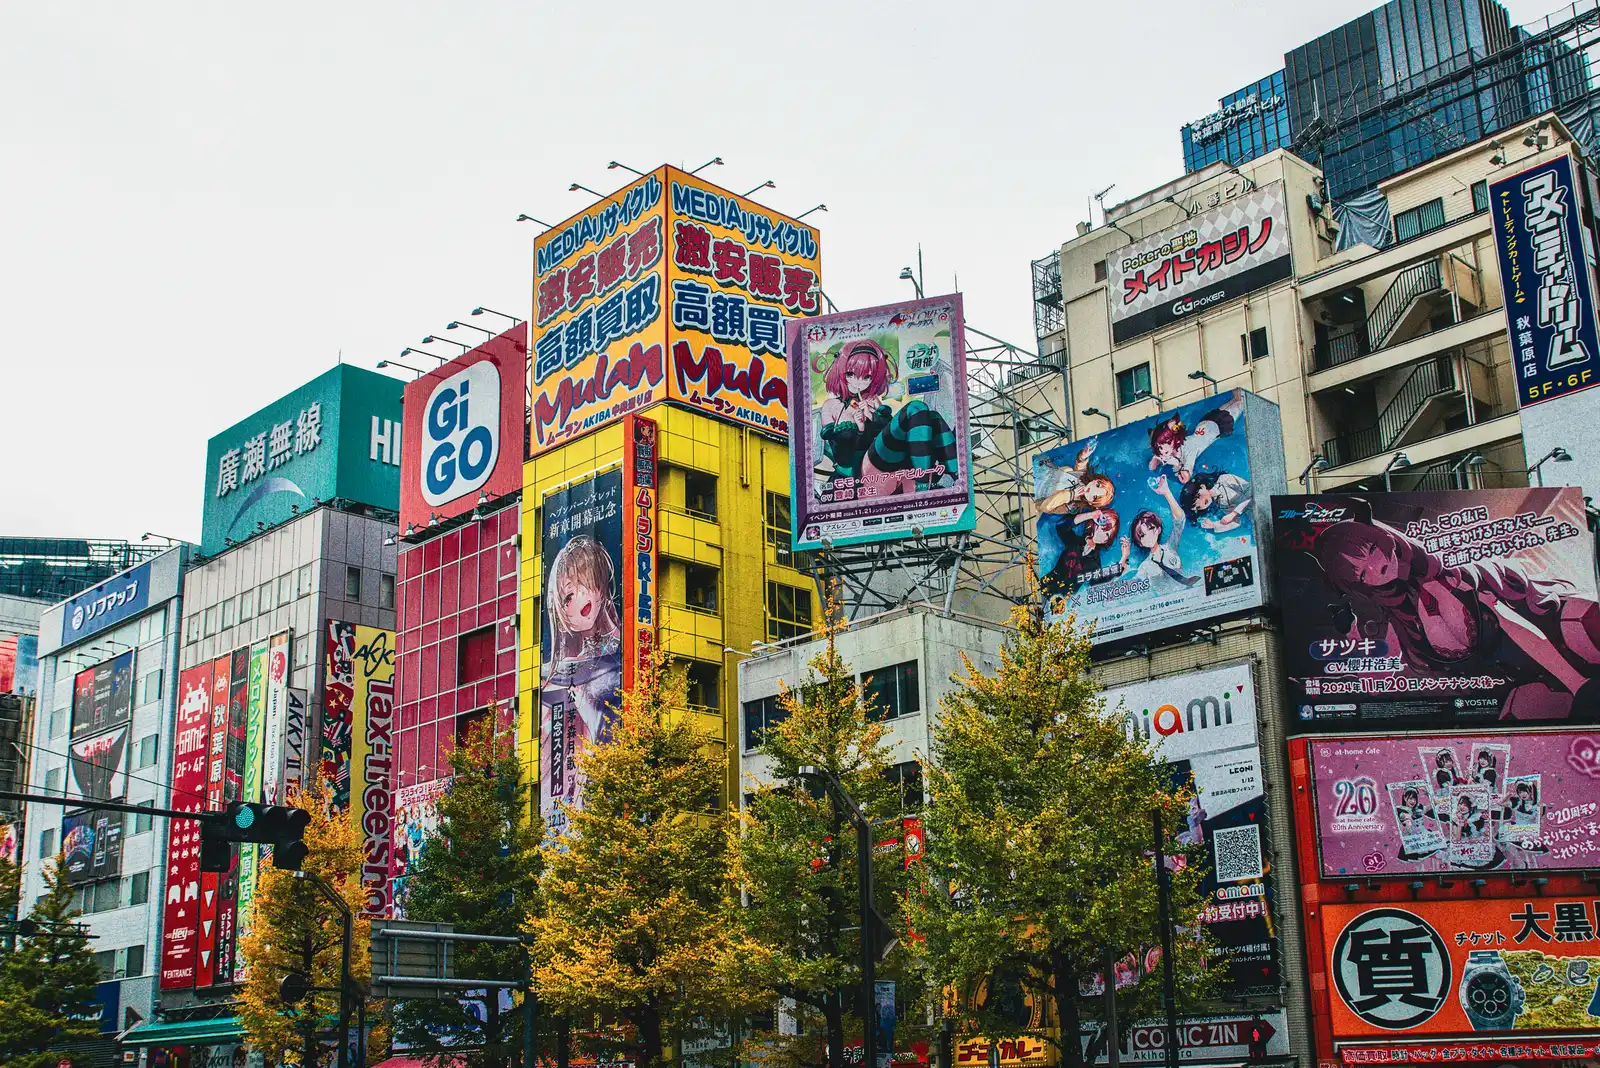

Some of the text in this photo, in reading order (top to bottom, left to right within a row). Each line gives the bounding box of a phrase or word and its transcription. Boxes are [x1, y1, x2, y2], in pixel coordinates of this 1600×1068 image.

[1192, 94, 1281, 143] 秋葉原ファーストビル
[537, 174, 662, 277] MEDIAリサイクル
[671, 181, 818, 260] MEDIAリサイクル
[1122, 230, 1198, 274] Pokerの聖地
[1124, 216, 1273, 304] メイドカジノ
[1502, 198, 1525, 298] トレーディングカードゲーム
[536, 215, 662, 326] 激安販売
[673, 220, 821, 316] 激安販売
[535, 272, 662, 385] 高額買取
[671, 279, 787, 358] 高額買
[829, 323, 874, 340] アズールレーン
[907, 344, 938, 360] コラボ
[911, 357, 933, 369] 開催
[1516, 314, 1538, 379] 秋葉原店
[534, 342, 664, 444] Mulan
[689, 393, 737, 414] ムーラン
[736, 407, 769, 427] AKIBA
[546, 420, 583, 447] ムーラン
[583, 408, 610, 430] AKIBA
[215, 402, 324, 498] 廣瀬無線
[426, 425, 493, 496] GO
[549, 500, 616, 539] 新章開幕記念
[636, 488, 653, 553] ムーラン
[826, 511, 937, 532] アズレン YOSTAR
[1278, 507, 1347, 519] ブルーアーカイブ
[1407, 505, 1488, 538] ふん、この私に
[1443, 526, 1580, 569] 油断ならないわね、先生。
[87, 580, 139, 622] ソフマップ
[1318, 637, 1377, 657] サツキ
[1464, 698, 1499, 706] YOSTAR
[177, 724, 206, 756] GAME
[247, 660, 262, 804] メロンブックス
[287, 691, 304, 759] AKKY
[192, 755, 206, 774] 4F
[552, 704, 564, 795] 記念スタイル
[1229, 765, 1254, 775] LEONI
[1335, 780, 1377, 817] 20
[1348, 823, 1384, 832] Anniversary
[1520, 821, 1600, 849] おかえりなさいま
[1217, 884, 1265, 899] amiami
[172, 927, 189, 941] Hey
[1454, 930, 1506, 946] チケット
[1510, 901, 1600, 944] 大黒
[166, 967, 193, 980] ENTRANCE
[1346, 923, 1443, 1015] 質
[1207, 1024, 1239, 1045] ZIN
[1344, 1047, 1388, 1062] 高価買取
